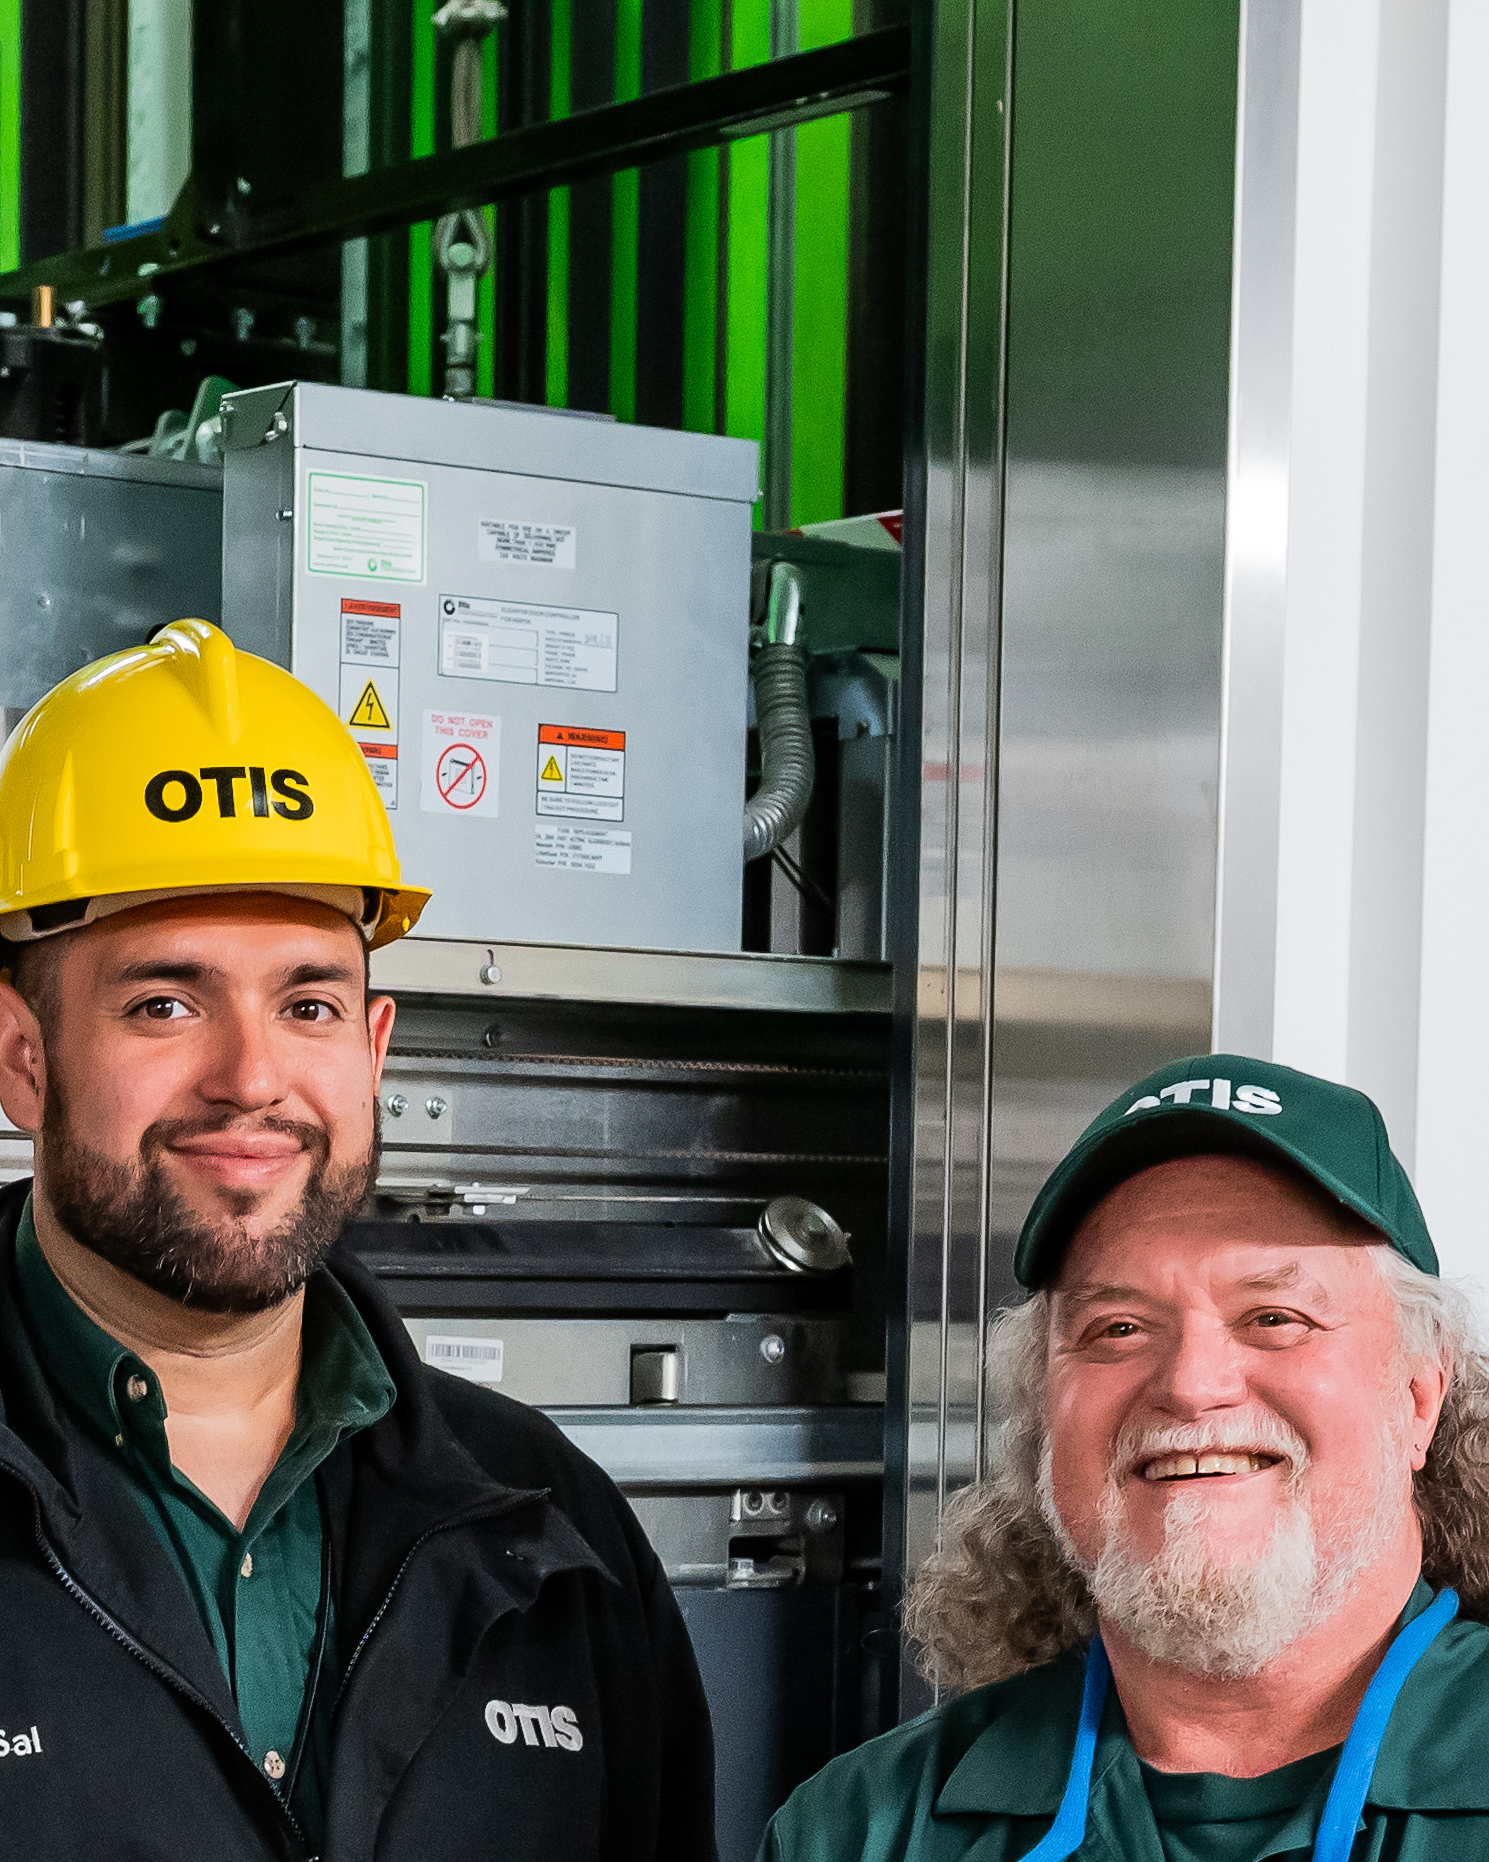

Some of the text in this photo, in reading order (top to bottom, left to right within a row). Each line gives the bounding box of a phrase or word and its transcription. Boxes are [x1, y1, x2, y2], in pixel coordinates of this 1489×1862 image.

[431, 714, 493, 728] DO NOT OPEN
[458, 728, 488, 739] COVER
[144, 766, 314, 823] OTIS
[484, 1699, 584, 1752] OTIS
